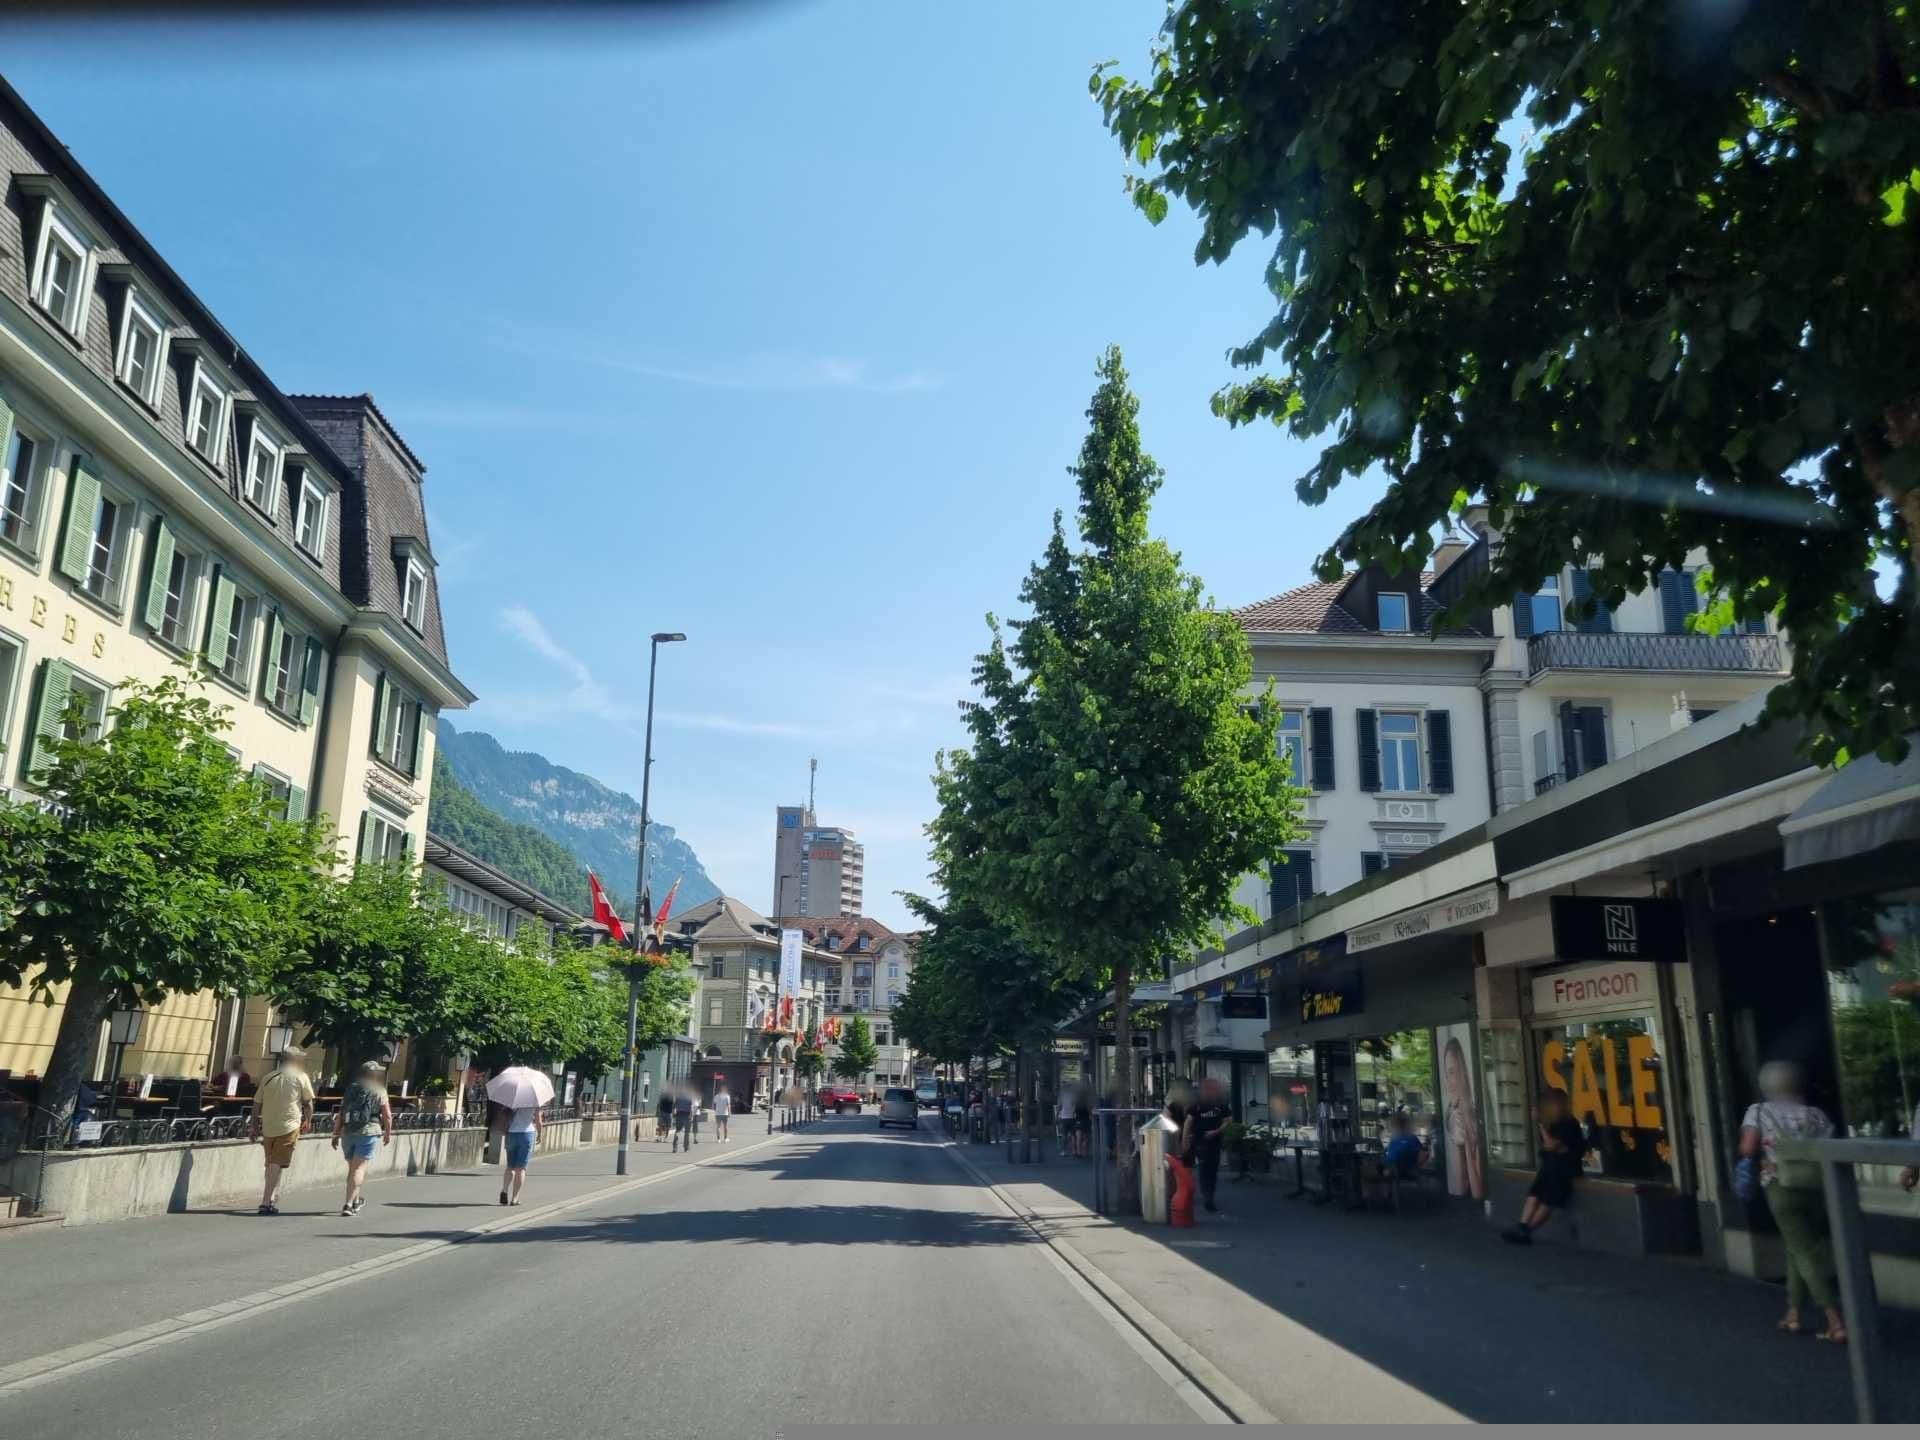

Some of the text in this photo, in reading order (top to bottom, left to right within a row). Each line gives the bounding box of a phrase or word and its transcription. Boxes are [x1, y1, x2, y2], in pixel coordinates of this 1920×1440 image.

[1607, 942, 1638, 953] NILE
[1553, 969, 1638, 1004] Francon
[1543, 1036, 1662, 1129] SALE
